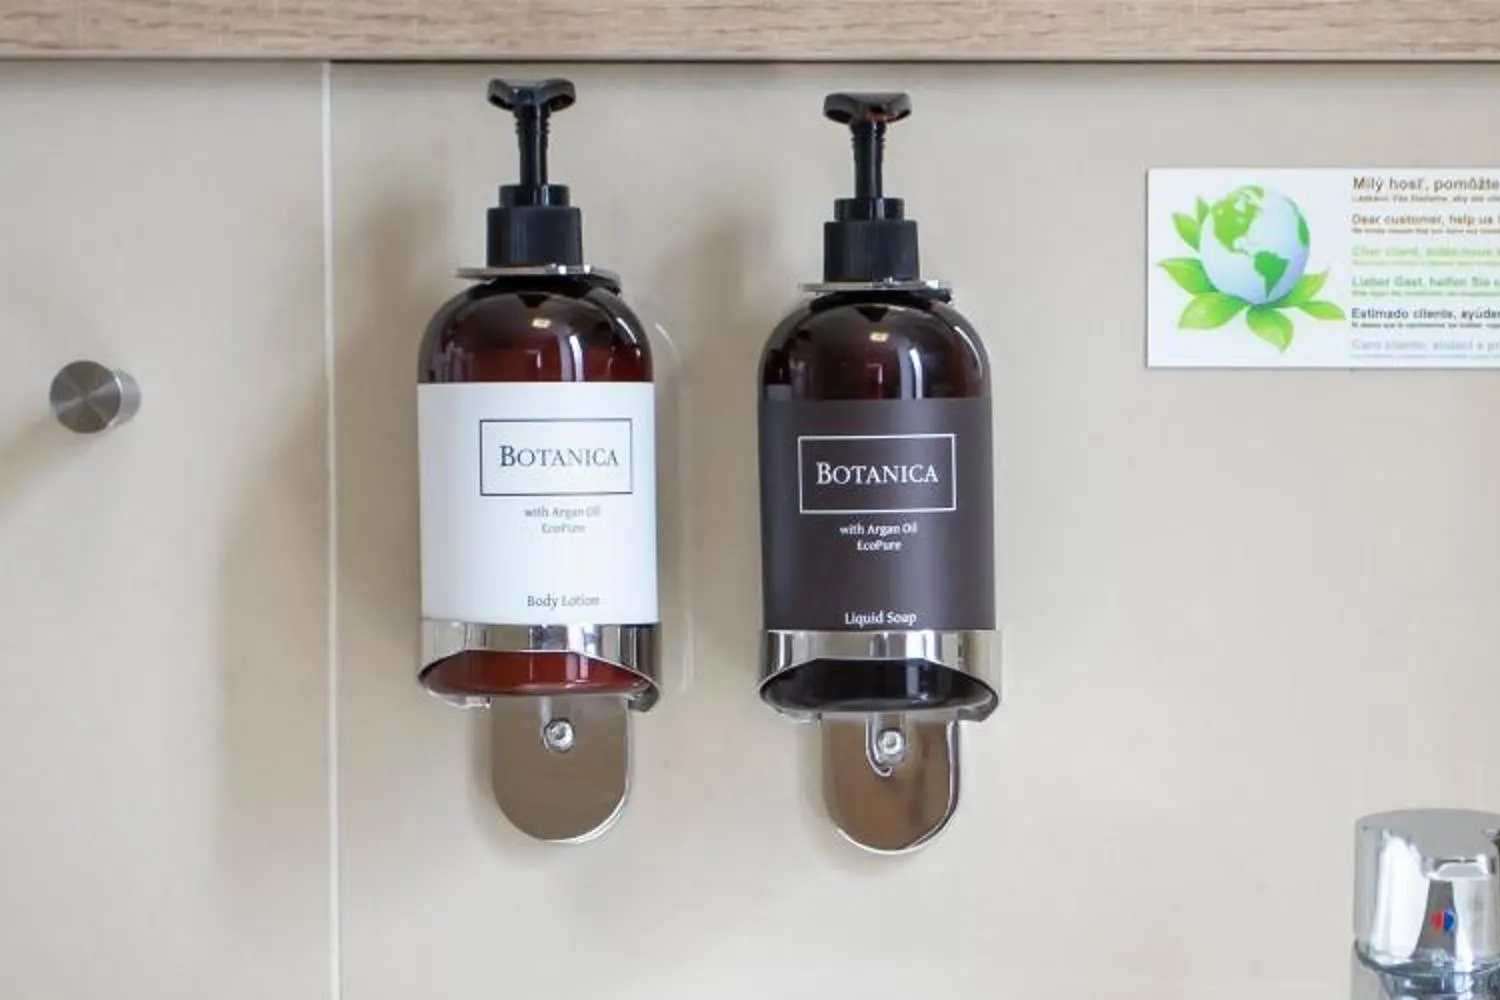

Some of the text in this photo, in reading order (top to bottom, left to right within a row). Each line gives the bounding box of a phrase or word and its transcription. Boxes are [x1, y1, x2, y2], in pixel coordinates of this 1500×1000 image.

[1353, 176, 1383, 192] Milý
[1352, 213, 1380, 225] Dear
[1449, 213, 1474, 228] help
[1352, 307, 1409, 319] Estimado
[499, 444, 619, 468] BOTANICA
[815, 461, 939, 485] BOTANICA
[525, 505, 549, 518] with
[552, 506, 584, 520] Argan
[839, 522, 865, 535] with
[867, 522, 900, 537] Argan
[856, 539, 902, 551] EcoPure
[527, 593, 600, 610] Body Lotion
[844, 610, 918, 627] Liquid Soap
